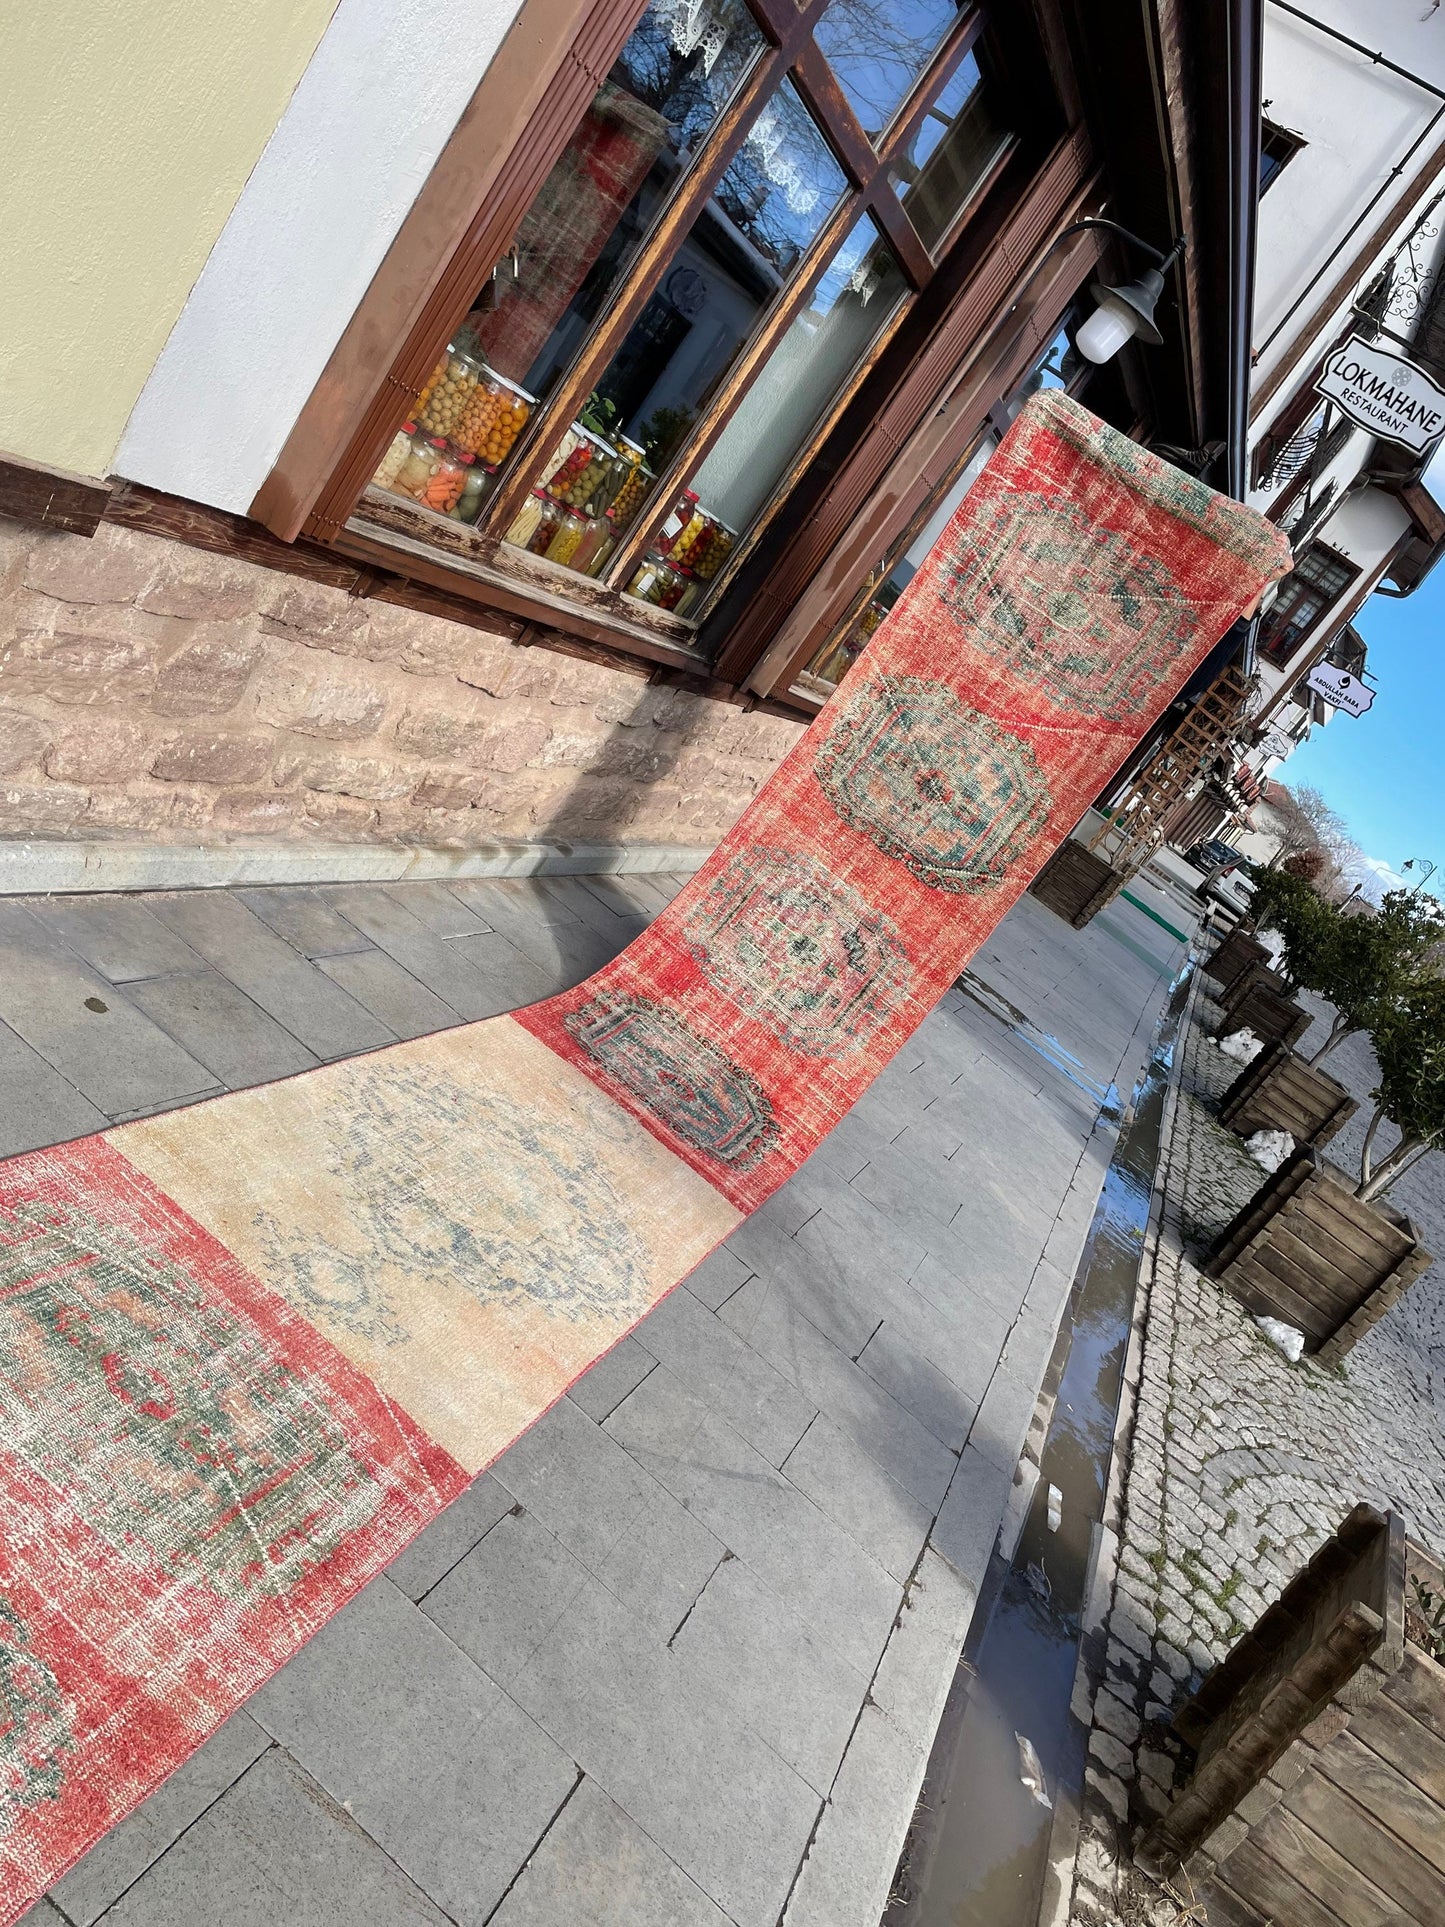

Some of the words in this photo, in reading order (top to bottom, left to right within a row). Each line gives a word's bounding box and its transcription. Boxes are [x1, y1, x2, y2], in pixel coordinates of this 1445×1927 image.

[1332, 355, 1442, 433] LOKMAHANE
[1340, 387, 1409, 434] RESTAURANT
[1313, 677, 1344, 698] ABDULLAH
[1343, 695, 1360, 708] BABA
[1323, 691, 1341, 705] VAKFI
